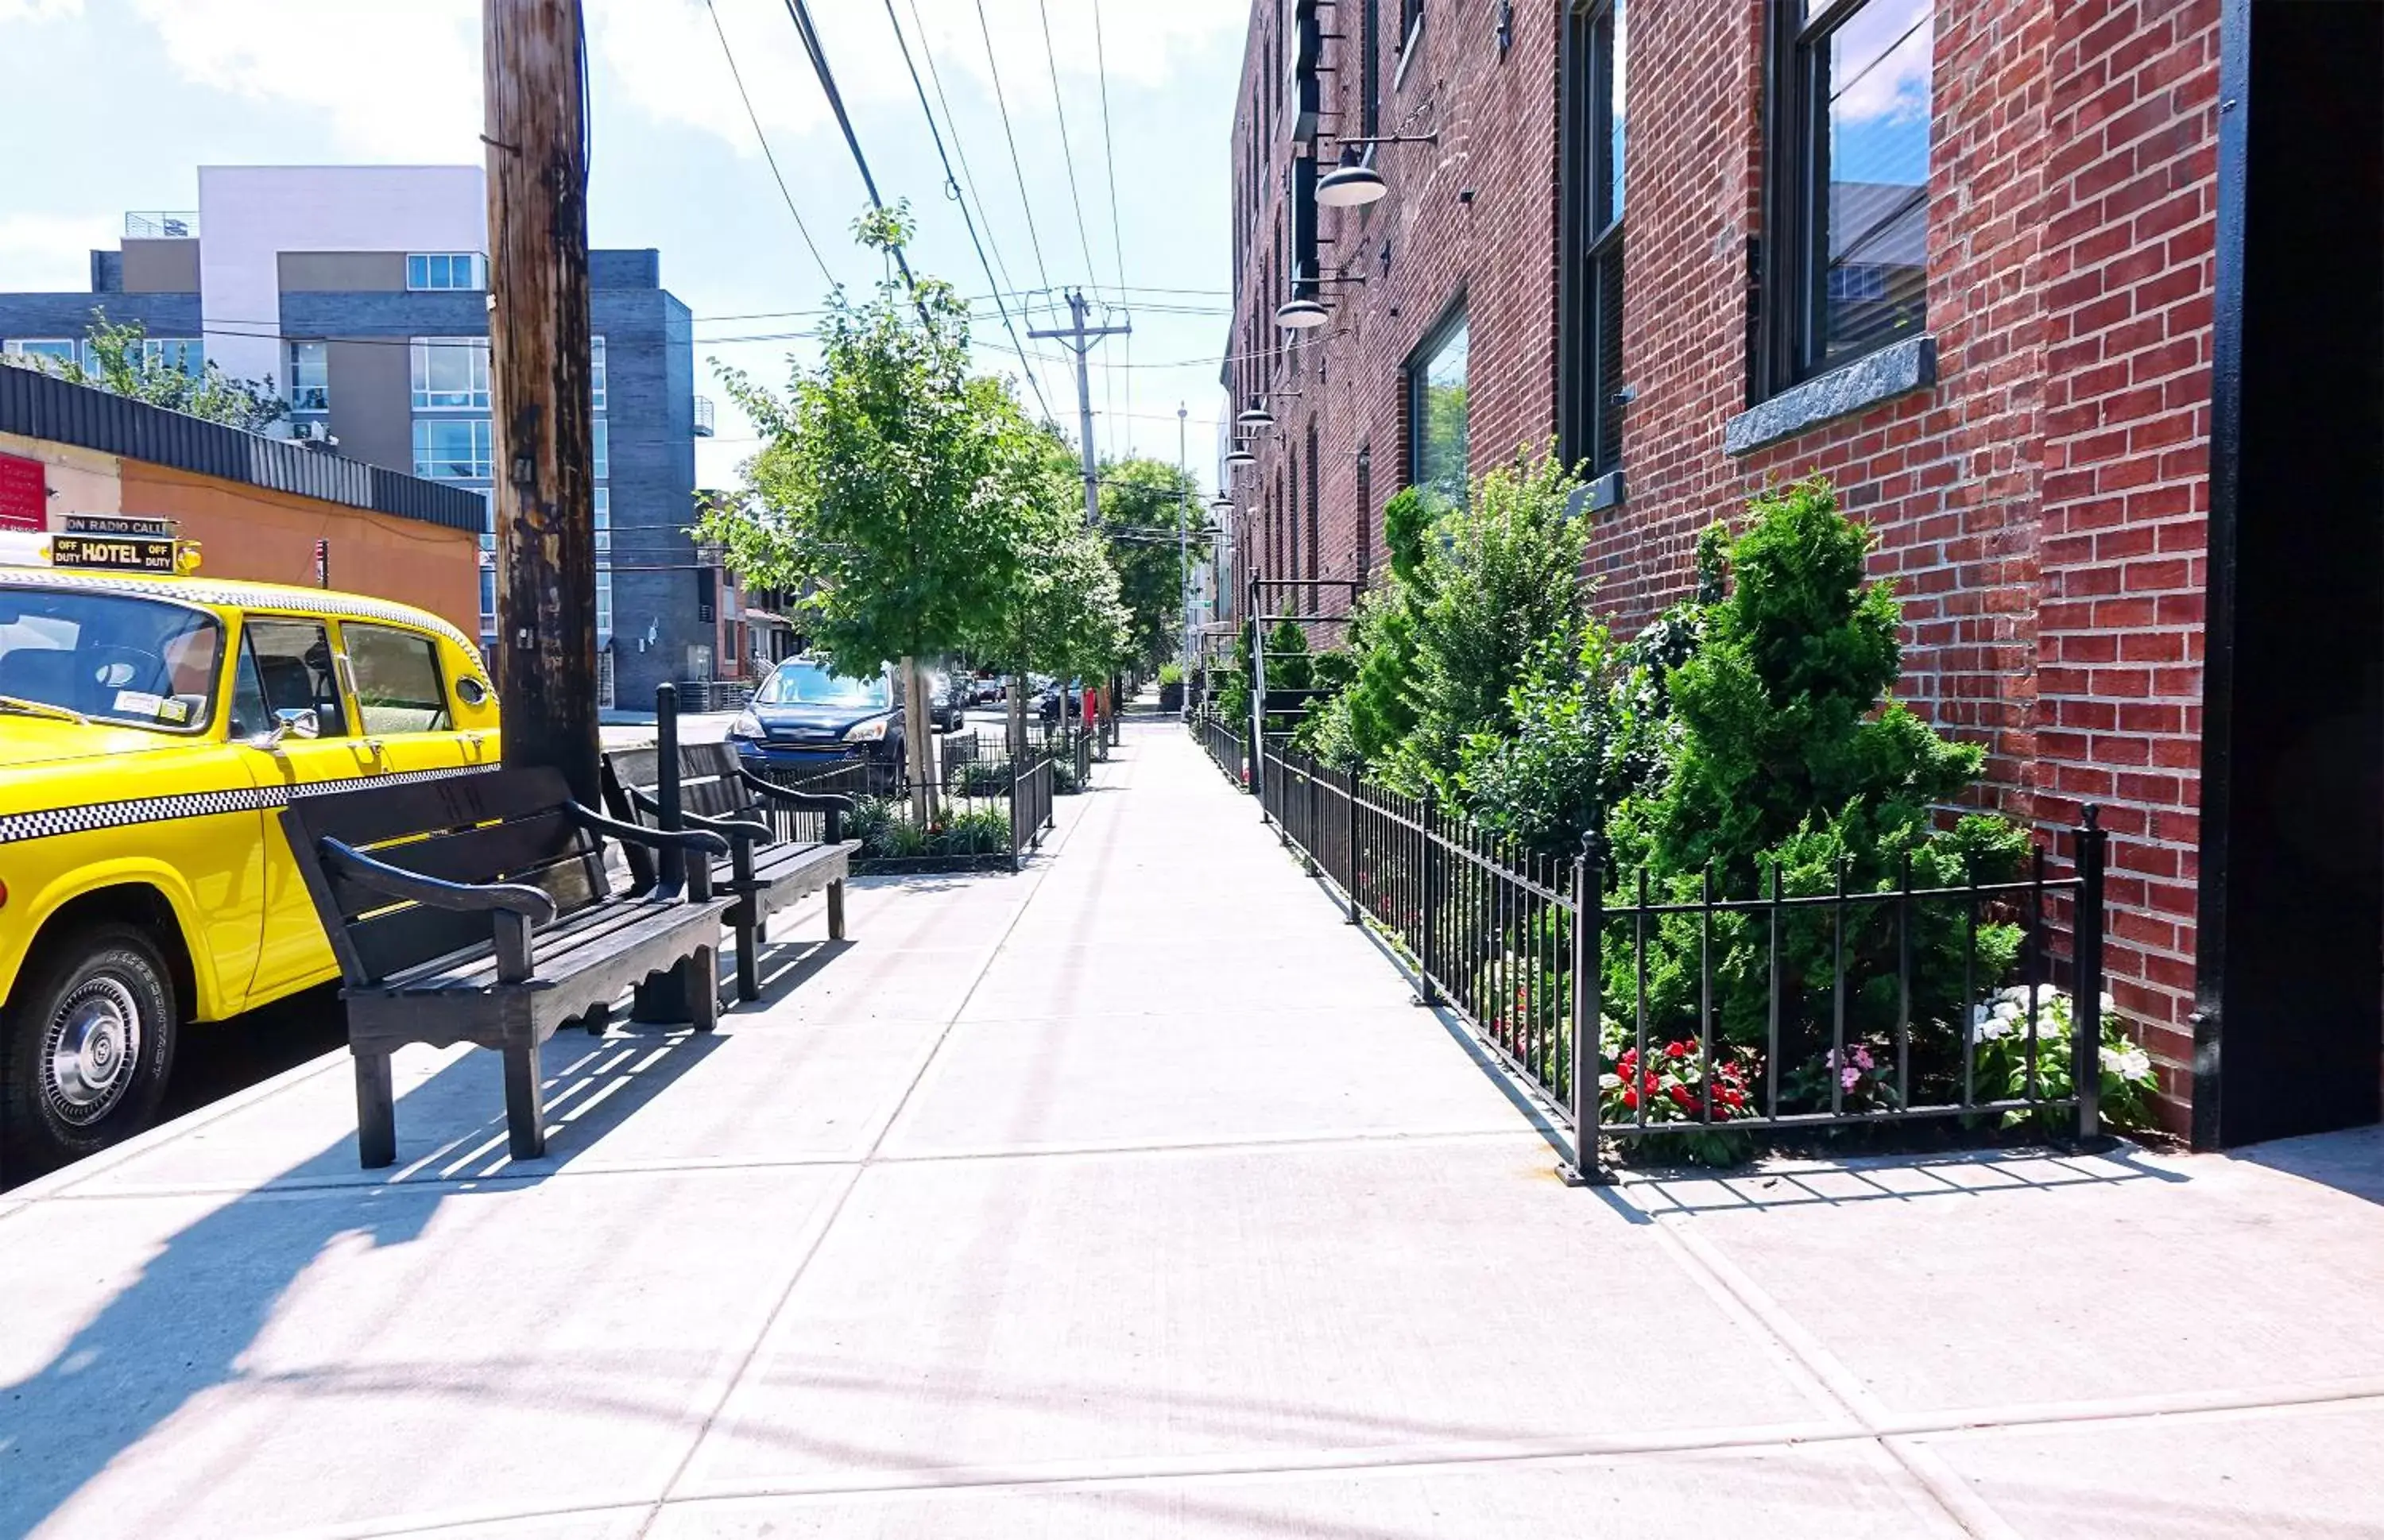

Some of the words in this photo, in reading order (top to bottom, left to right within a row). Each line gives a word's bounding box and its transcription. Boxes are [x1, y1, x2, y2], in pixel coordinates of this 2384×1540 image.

[68, 519, 85, 530] ON
[89, 520, 129, 532] RADIO
[133, 522, 161, 534] CALL
[58, 540, 78, 551] OFF
[149, 545, 168, 555] OFF
[56, 552, 80, 563] DUTY
[82, 543, 141, 563] HOTEL
[145, 557, 171, 567] DUTY
